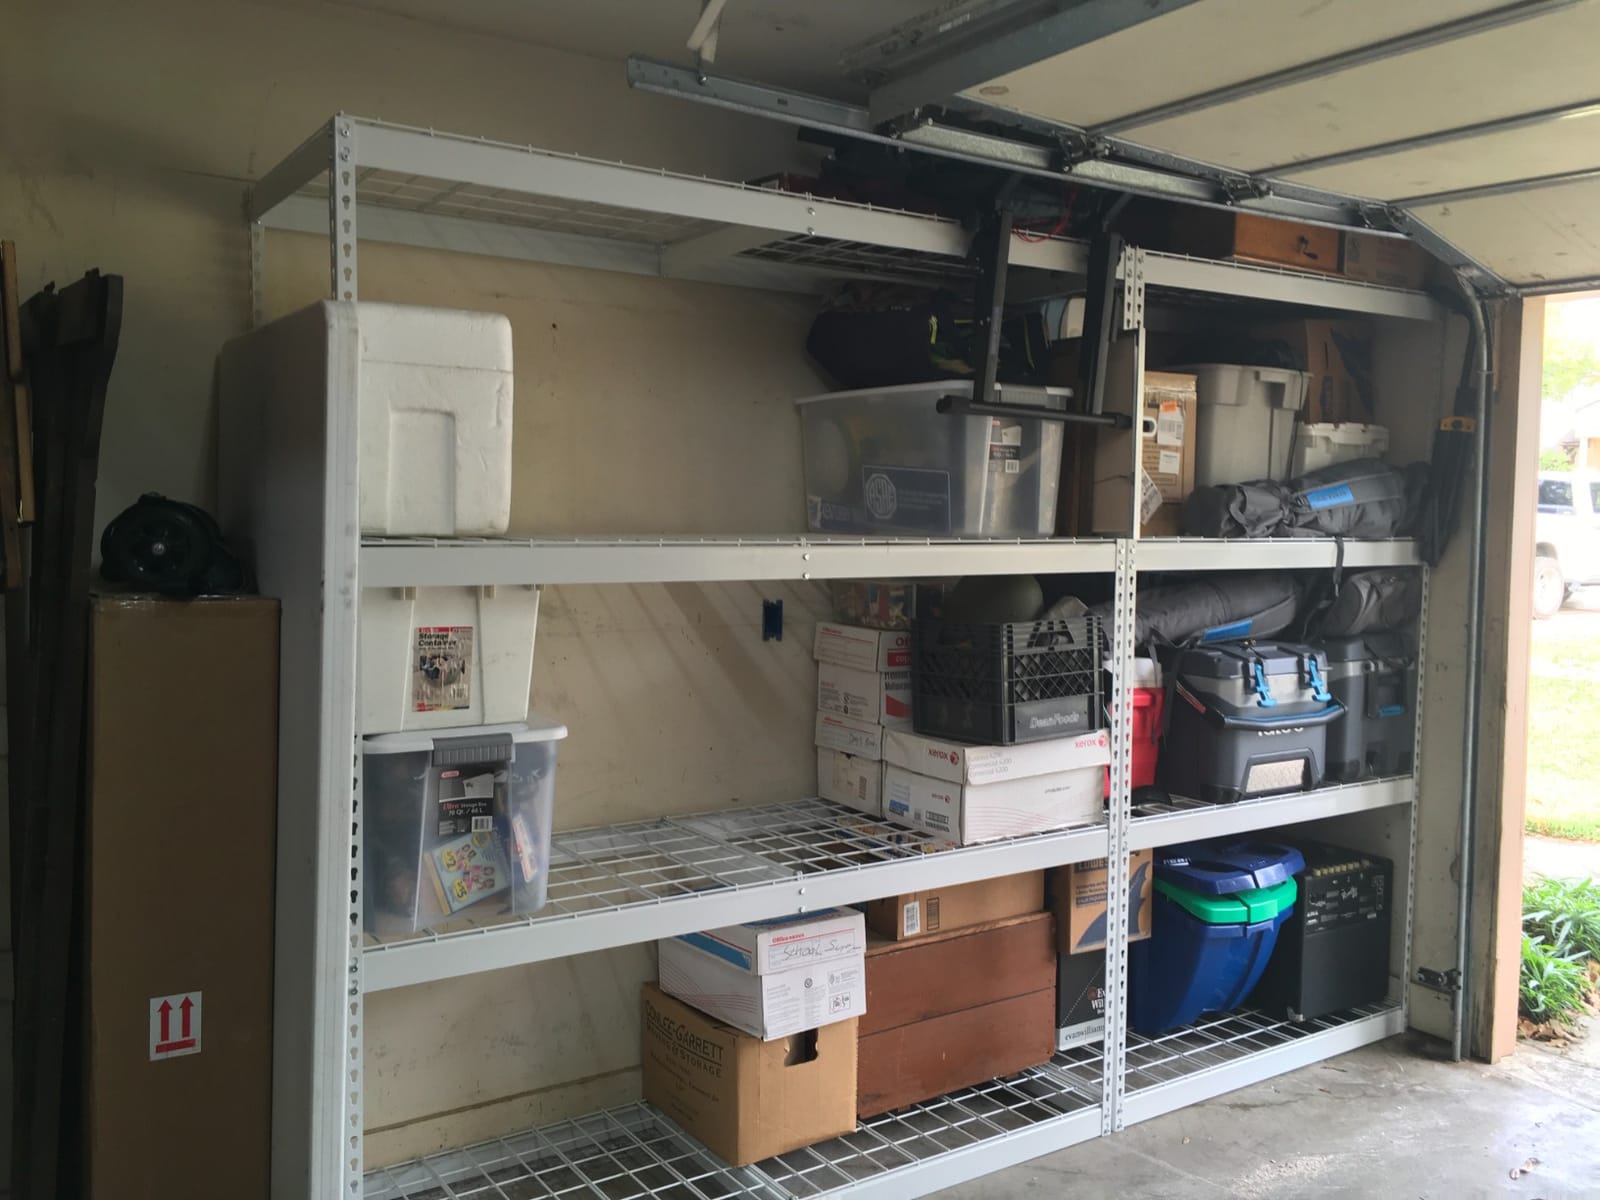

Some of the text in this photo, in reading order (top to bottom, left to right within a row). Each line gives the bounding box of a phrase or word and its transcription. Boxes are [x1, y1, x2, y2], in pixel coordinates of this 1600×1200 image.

[418, 633, 450, 641] Storage
[418, 640, 458, 648] Container
[1074, 738, 1097, 749] xerox
[928, 748, 949, 760] xerox
